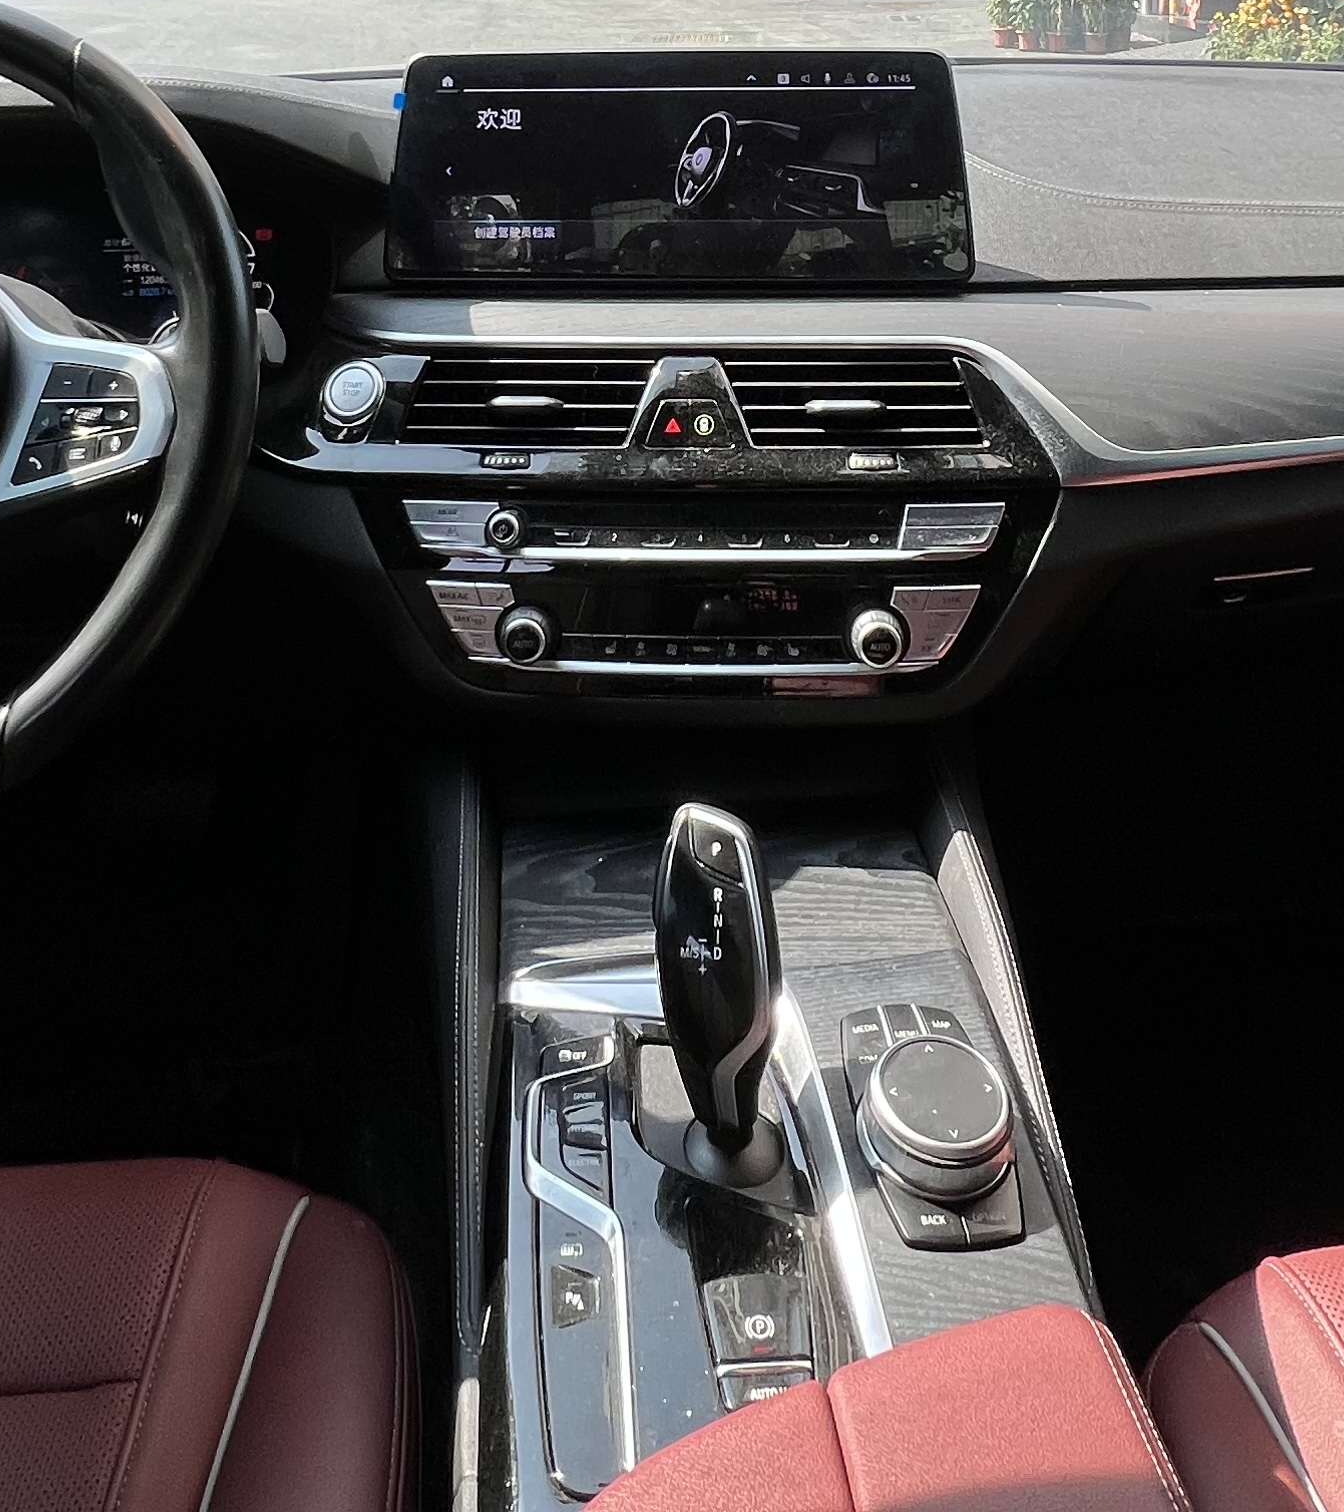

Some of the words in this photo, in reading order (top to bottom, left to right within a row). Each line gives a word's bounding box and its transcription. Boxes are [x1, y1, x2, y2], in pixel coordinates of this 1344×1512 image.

[476, 108, 522, 130] 欢迎
[512, 638, 534, 648] AUTO
[870, 642, 891, 651] AUTO
[711, 841, 722, 857] P
[713, 887, 723, 902] R
[713, 914, 723, 928] N
[680, 946, 699, 959] M/S
[713, 946, 722, 961] D
[852, 1023, 879, 1034] MEDIA
[932, 1019, 951, 1029] MAP
[573, 1092, 597, 1100] SPORT
[920, 1214, 948, 1227] BACK
[750, 1387, 779, 1401] AUTO
